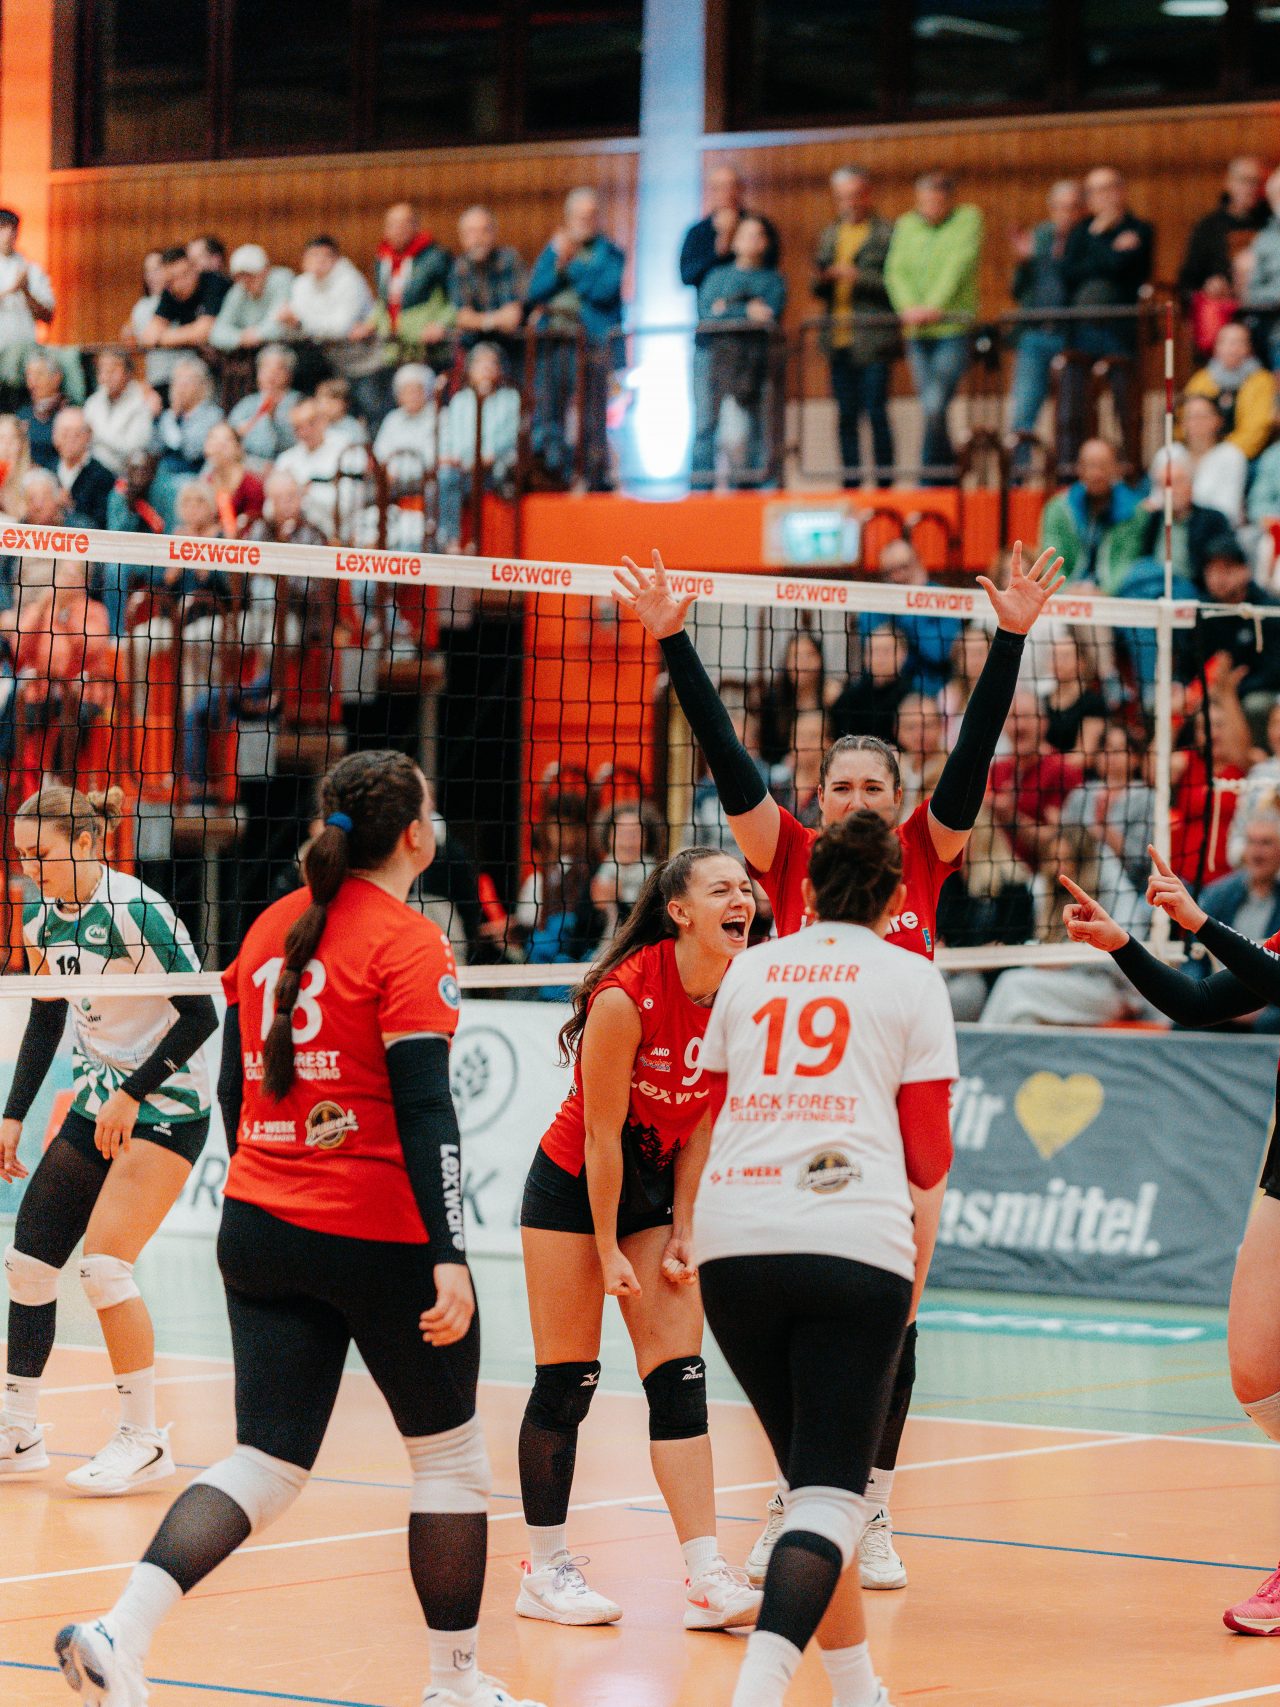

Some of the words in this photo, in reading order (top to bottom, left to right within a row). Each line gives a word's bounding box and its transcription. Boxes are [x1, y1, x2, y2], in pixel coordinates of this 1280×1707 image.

[0, 528, 89, 553] exware
[168, 541, 260, 565] Lexware
[336, 553, 421, 576] Lexware
[491, 564, 572, 586] Lexware
[776, 583, 848, 604] Lexware
[765, 964, 860, 983] REDERER
[752, 997, 851, 1077] 19
[682, 1037, 705, 1086] 9
[787, 1092, 858, 1111] FOREST
[440, 1144, 465, 1250] Lexware
